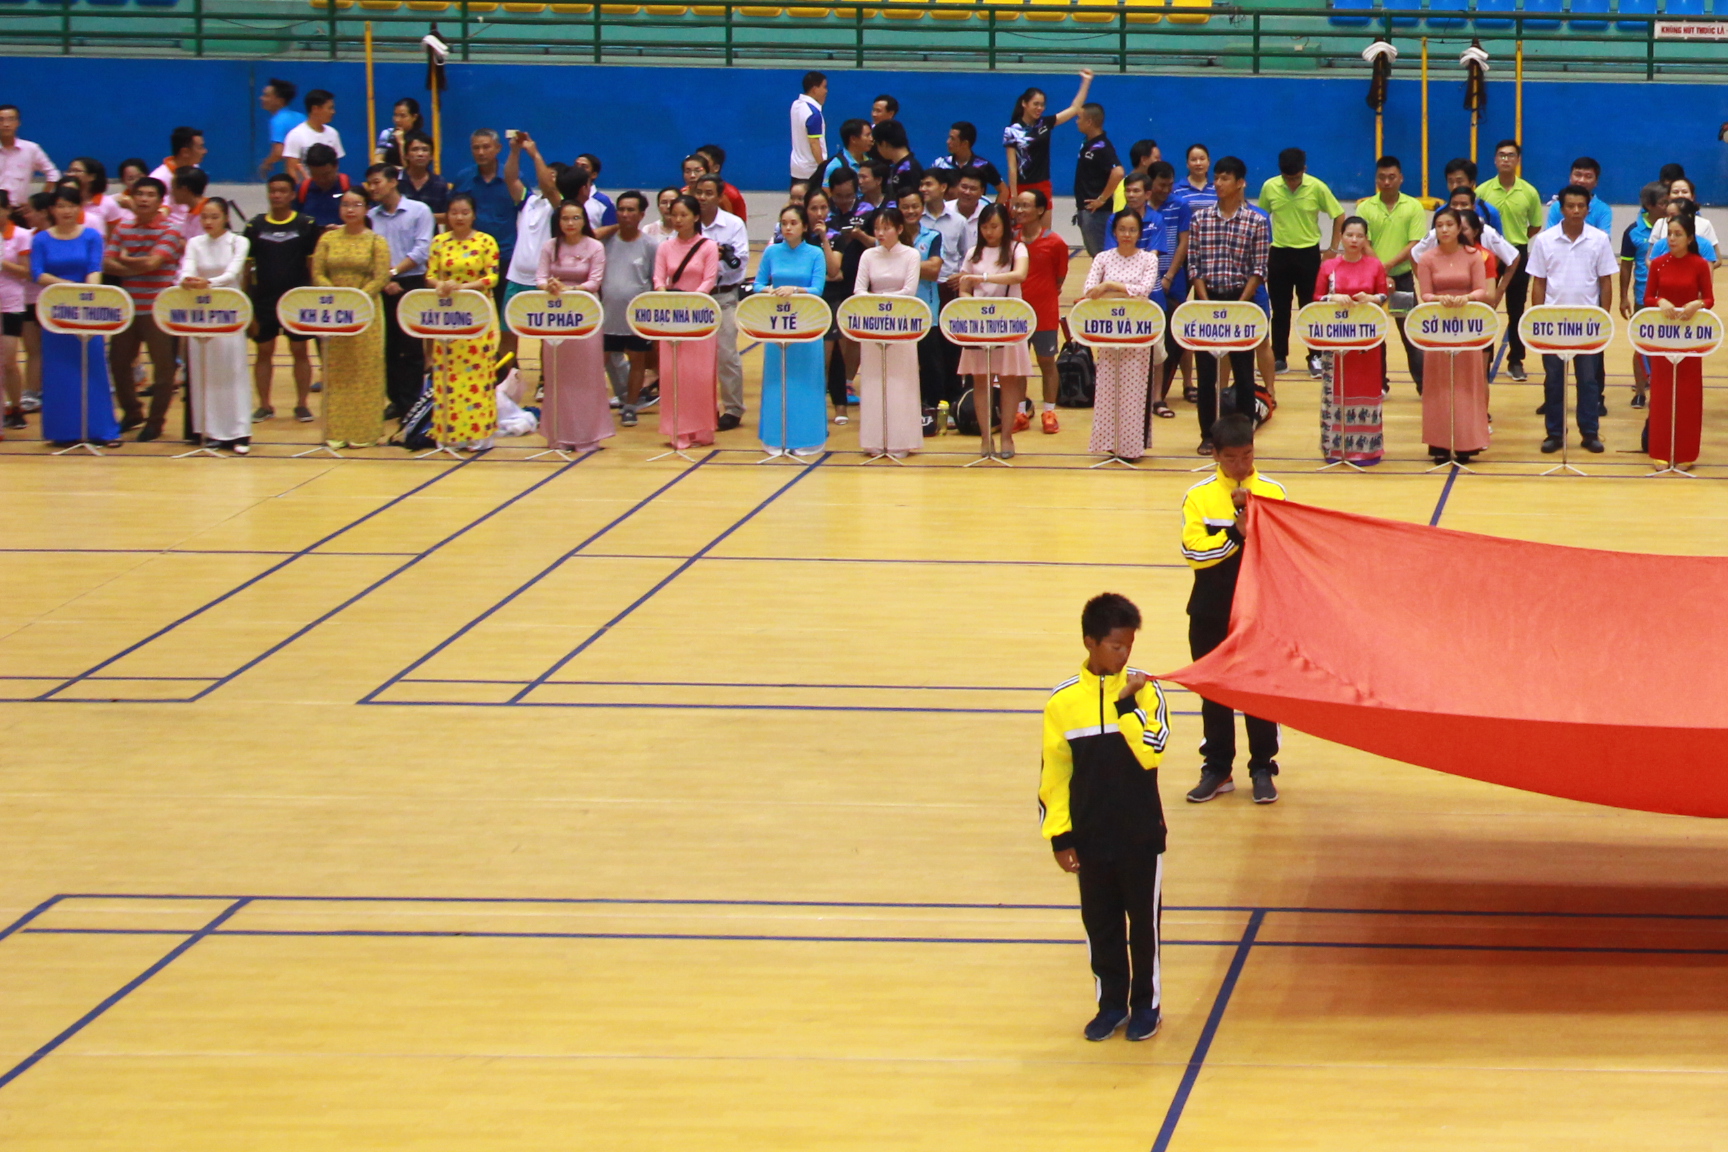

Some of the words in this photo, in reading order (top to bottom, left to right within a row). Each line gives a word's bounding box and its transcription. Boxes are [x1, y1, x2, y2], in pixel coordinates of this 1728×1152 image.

[300, 310, 316, 322] KH
[321, 310, 331, 322] &
[335, 310, 353, 323] CN
[421, 311, 439, 325] XÂY
[443, 312, 472, 329] DỰNG
[527, 312, 544, 326] TƯ
[548, 310, 583, 326] PHÁP
[635, 309, 651, 322] KHO
[654, 310, 670, 325] BẠC
[673, 307, 689, 322] NHÀ
[692, 309, 714, 323] NƯỚC
[770, 316, 778, 329] Y
[782, 312, 798, 329] TẾ
[848, 316, 860, 328] TÀI
[863, 315, 895, 331] NGUYÊN
[898, 317, 909, 331] VÀ
[911, 318, 922, 331] MT
[1085, 320, 1113, 334] LĐTB
[1118, 319, 1132, 334] VÀ
[1136, 321, 1152, 334] XH
[1184, 322, 1196, 337] KẾ
[1200, 324, 1231, 341] HOẠCH
[1234, 325, 1241, 338] &
[1244, 325, 1256, 338] ĐT
[1309, 323, 1324, 337] TÀI
[1327, 322, 1356, 337] CHÍNH
[1359, 324, 1376, 337] TTH
[1423, 316, 1439, 333] SỞ
[1443, 318, 1464, 336] NỘI
[1468, 318, 1483, 335] VỤ
[1533, 322, 1553, 336] BTC
[1558, 318, 1582, 336] TỈNH
[1586, 319, 1600, 336] ỦY
[1640, 325, 1654, 339] CQ
[1658, 325, 1680, 339] ĐUK
[1684, 326, 1693, 339] &
[1696, 326, 1712, 339] DN
